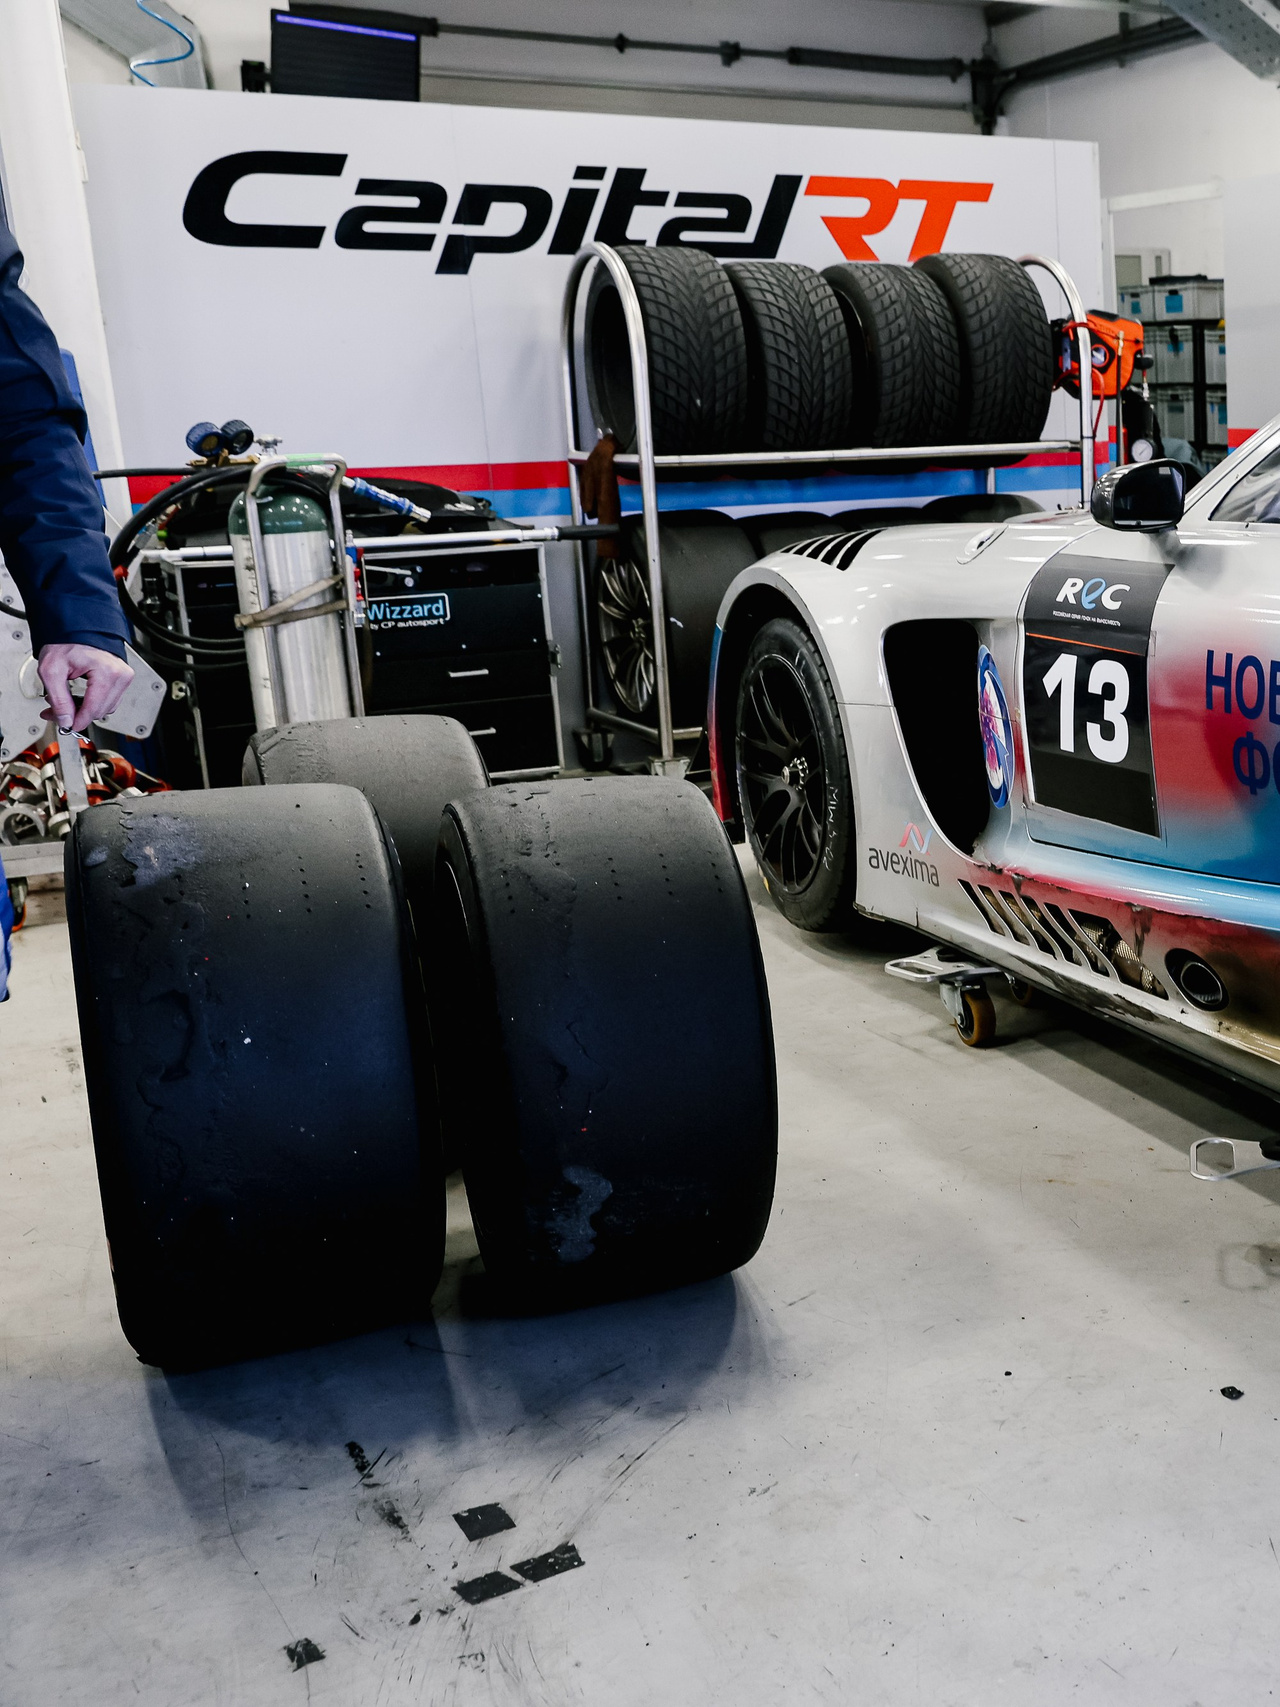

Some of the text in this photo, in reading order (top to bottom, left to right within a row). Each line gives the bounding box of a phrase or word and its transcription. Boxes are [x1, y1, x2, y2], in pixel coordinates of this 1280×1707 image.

[367, 599, 445, 620] Wizzard
[397, 618, 444, 628] autosport
[1042, 652, 1130, 764] 13
[868, 847, 940, 887] avexima
